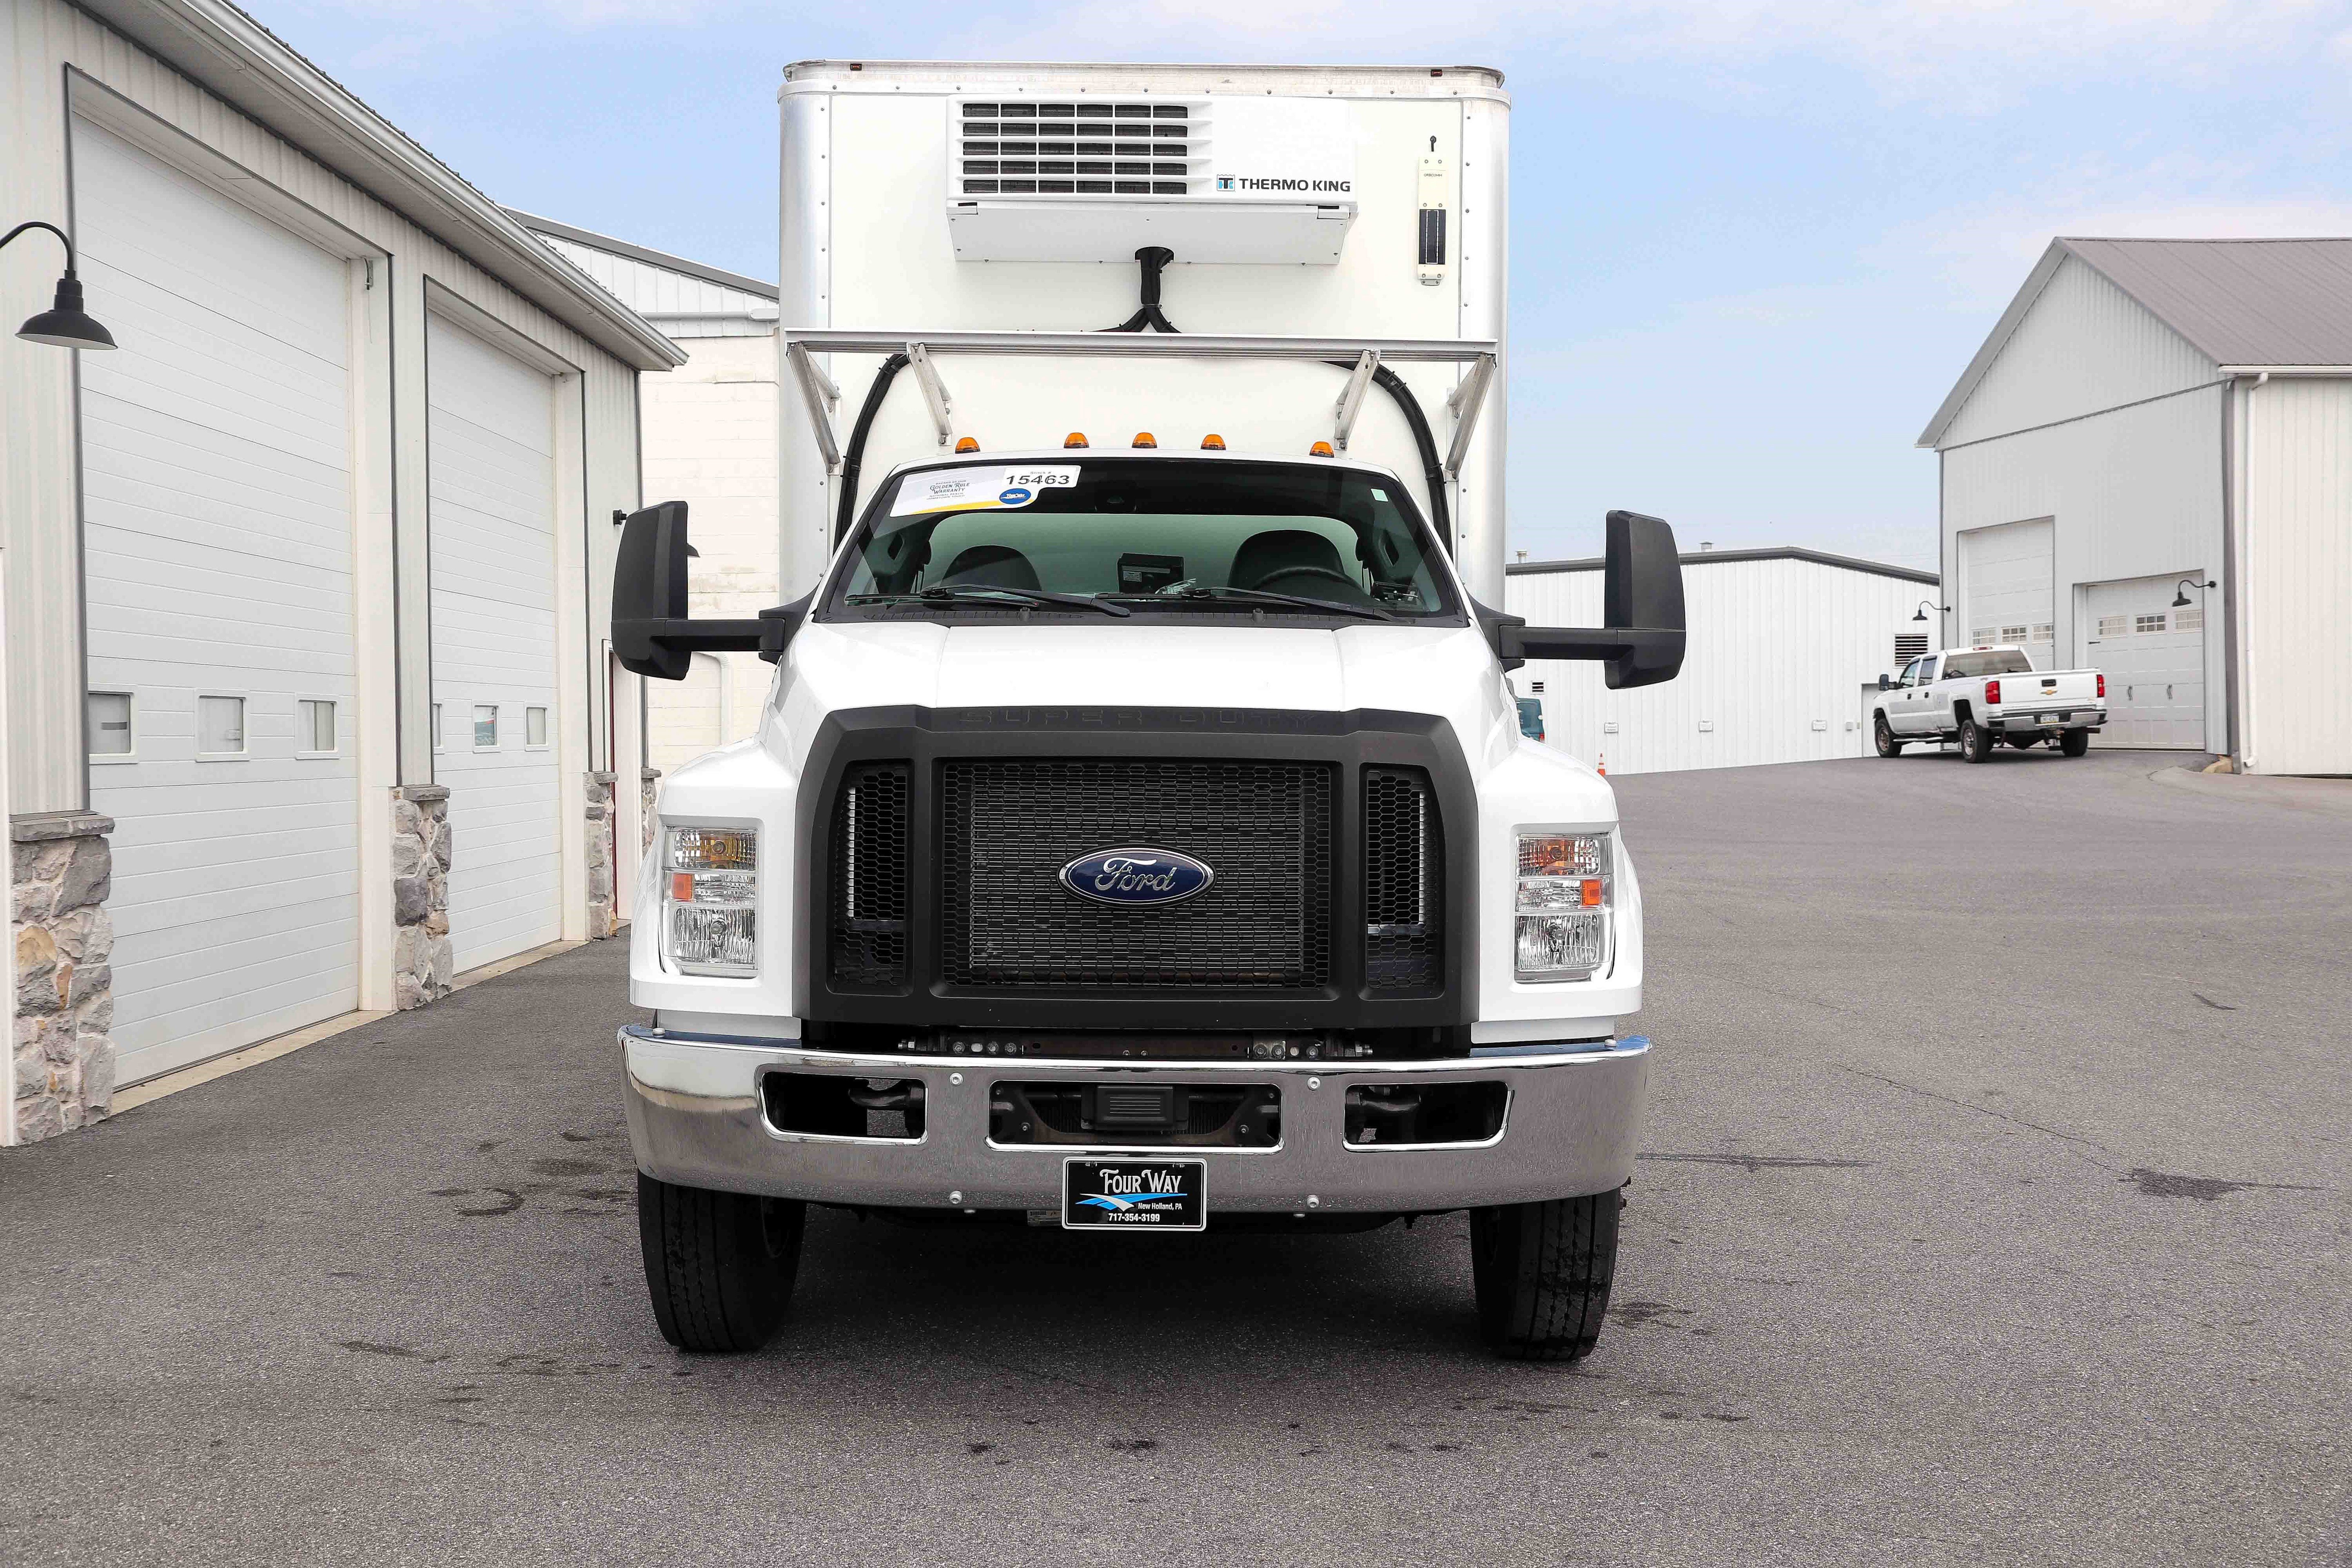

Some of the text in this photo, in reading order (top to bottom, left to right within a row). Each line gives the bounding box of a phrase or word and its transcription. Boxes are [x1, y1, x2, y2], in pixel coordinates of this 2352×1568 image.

[1239, 178, 1309, 191] THERMO
[1312, 180, 1351, 192] KING
[1006, 475, 1070, 485] 15463
[960, 709, 1315, 728] SUPER DUTY
[1094, 857, 1178, 891] Ford
[1152, 1202, 1174, 1211] Holland,
[1108, 1212, 1160, 1222] 717-354-3199
